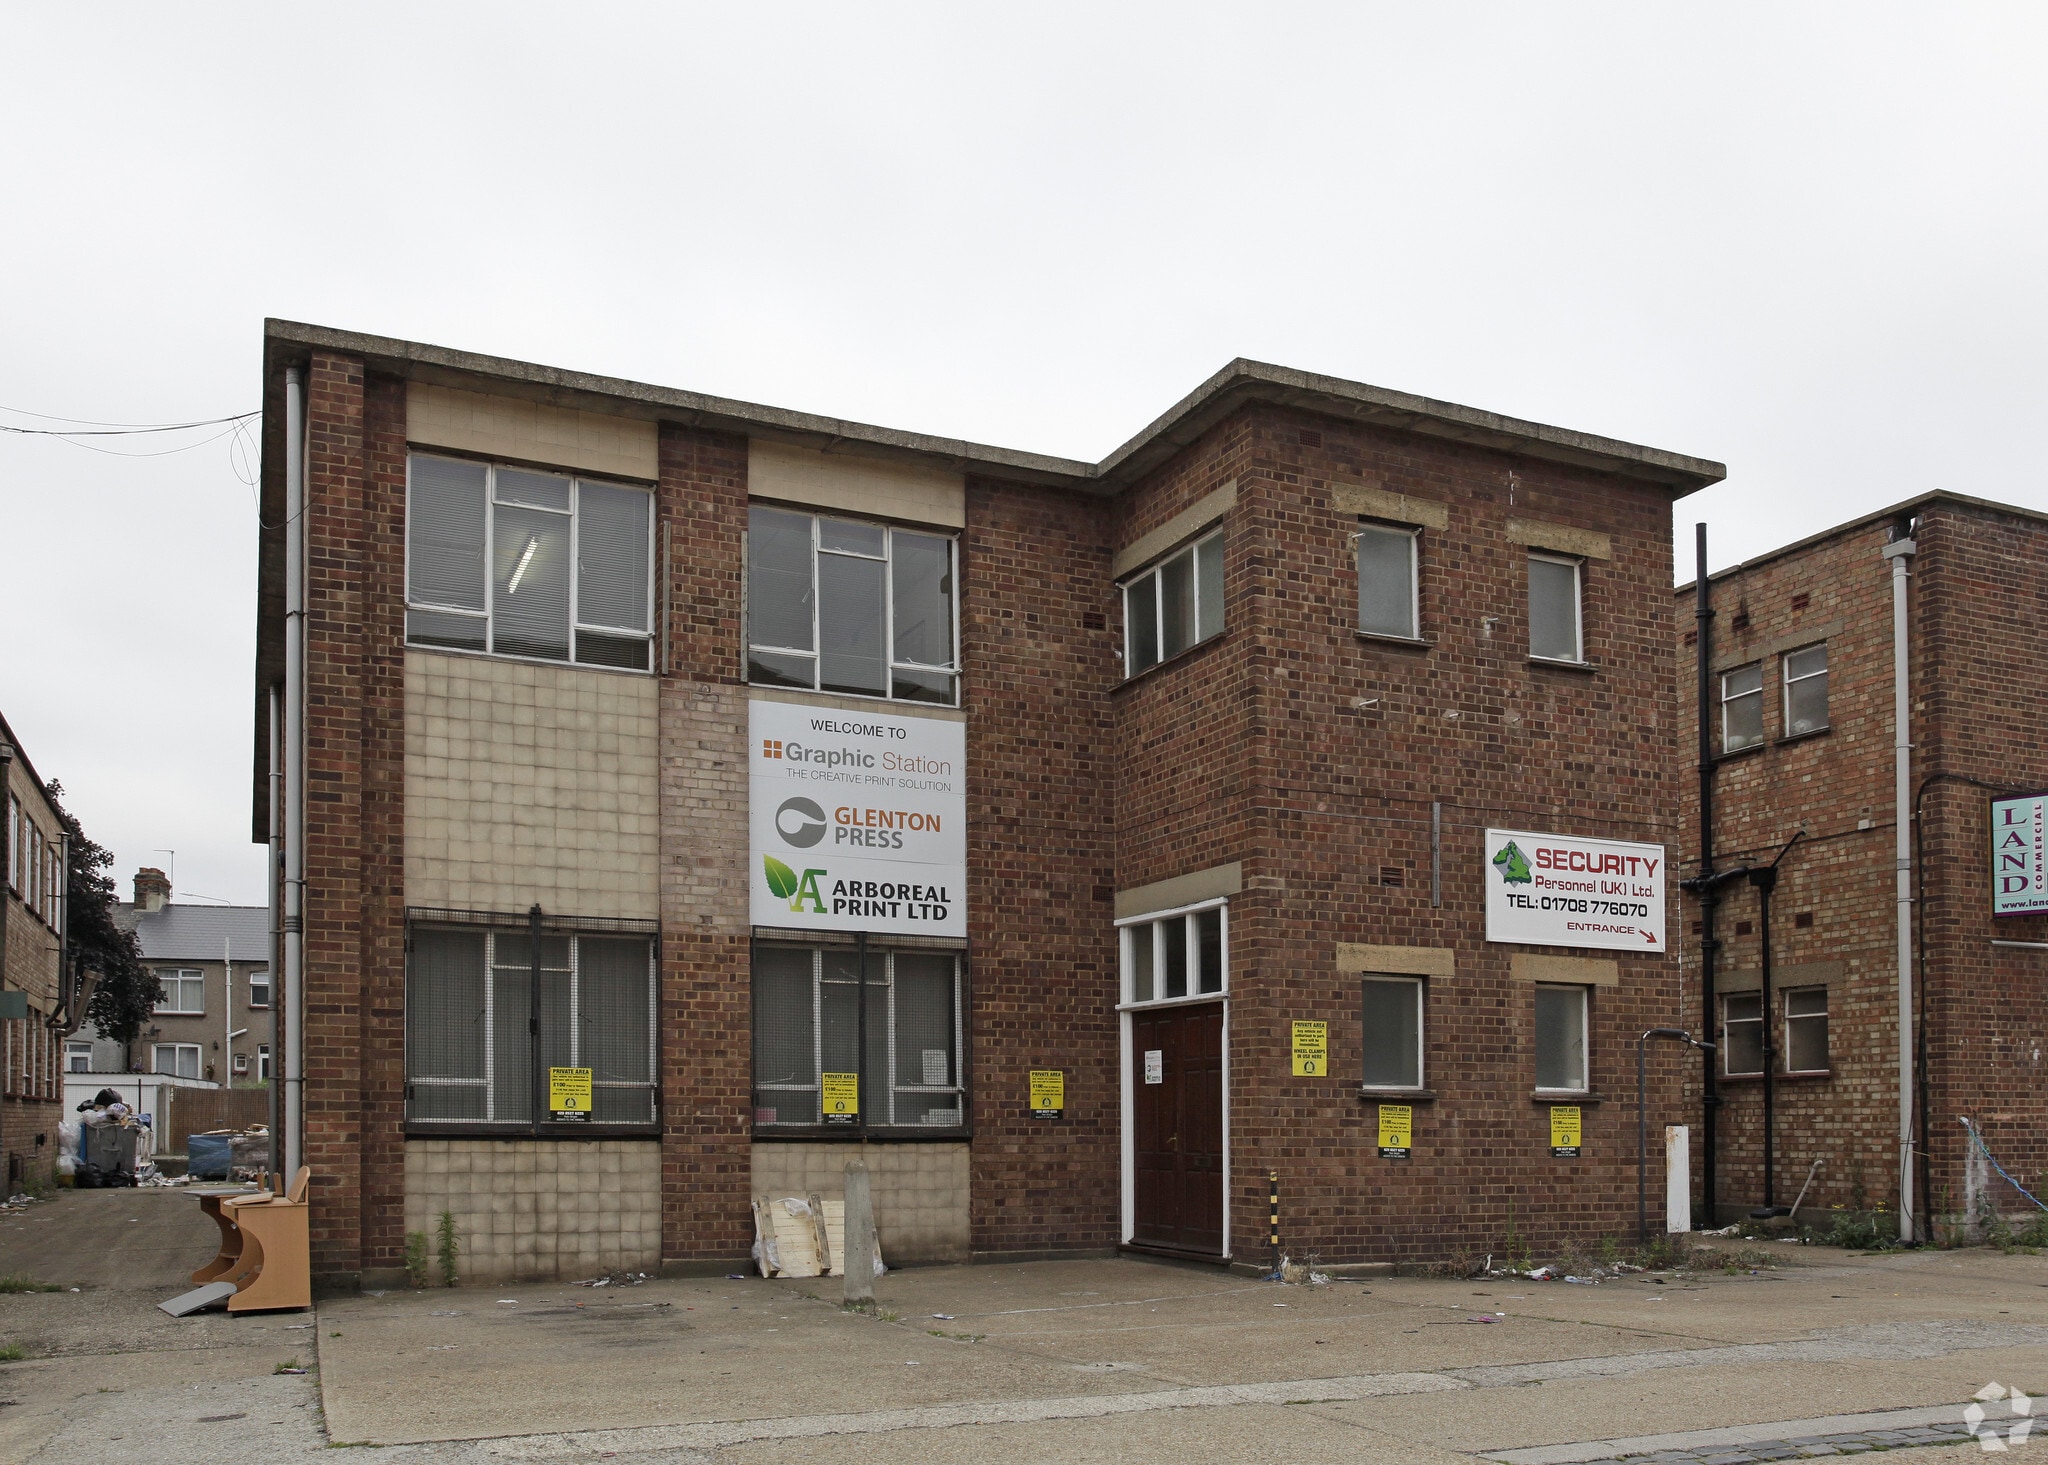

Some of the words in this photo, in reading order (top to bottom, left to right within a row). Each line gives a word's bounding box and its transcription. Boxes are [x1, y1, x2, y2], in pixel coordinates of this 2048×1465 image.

[810, 719, 884, 738] WELCOME
[888, 727, 906, 739] TO
[785, 742, 875, 768] Graphic
[882, 751, 951, 775] Station
[786, 768, 807, 779] THE
[810, 770, 862, 784] CREATIVE
[865, 775, 896, 787] PRINT
[898, 778, 951, 792] SOLUTION
[834, 806, 941, 832] GLENTON
[835, 826, 903, 850] PRESS
[1536, 848, 1659, 878] SECURITY
[832, 879, 952, 903] ARBOREAL
[1535, 875, 1596, 892] Personnel
[1601, 881, 1627, 895] (UK)
[1632, 884, 1655, 898] Ltd.
[833, 898, 901, 918] PRINT
[908, 903, 948, 921] LTD
[1507, 894, 1538, 909] TEL:
[1541, 897, 1588, 913] 01708
[1590, 900, 1648, 917] 776070
[1567, 922, 1635, 934] ENTRANCE
